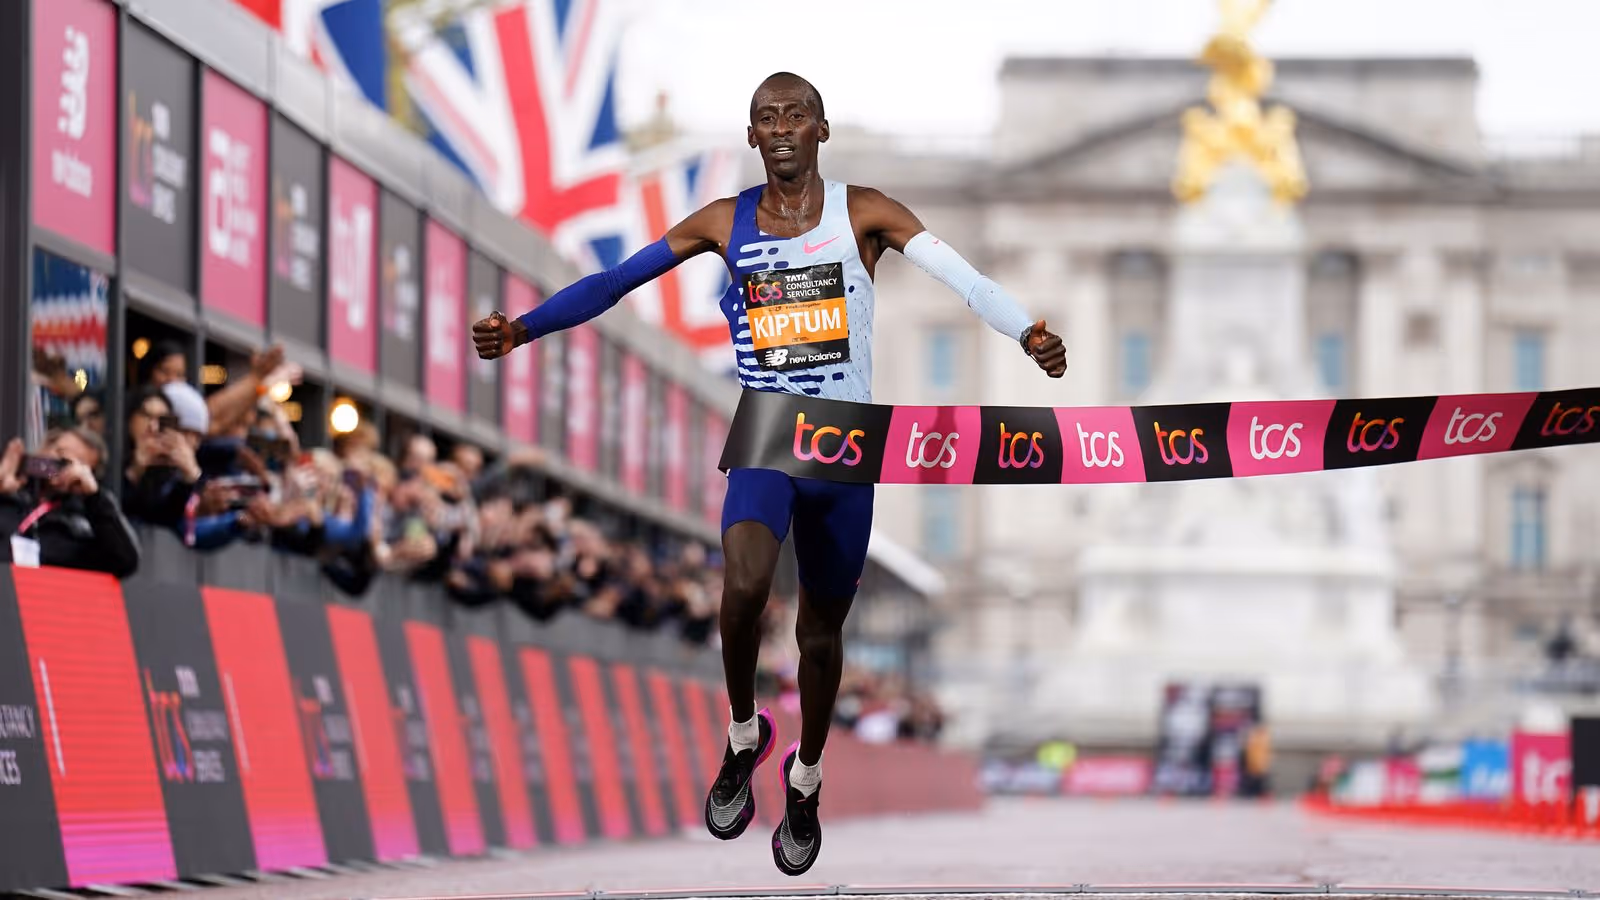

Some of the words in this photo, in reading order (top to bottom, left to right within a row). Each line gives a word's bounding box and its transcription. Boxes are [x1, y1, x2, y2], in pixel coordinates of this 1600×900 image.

[748, 280, 783, 303] tcs
[785, 274, 808, 282] TATA
[786, 277, 838, 290] CONSULTANCY
[787, 288, 821, 298] SERVICES
[754, 308, 841, 339] KIPTUM
[789, 355, 807, 364] new
[808, 351, 842, 363] balance
[793, 412, 865, 466] tcs
[905, 421, 959, 469] tcs
[998, 422, 1045, 469] tcs
[1076, 422, 1124, 468] tcs
[1153, 421, 1208, 466] tcs
[1248, 416, 1303, 460] tcs
[1347, 412, 1404, 453] tcs
[1444, 406, 1502, 445] tcs
